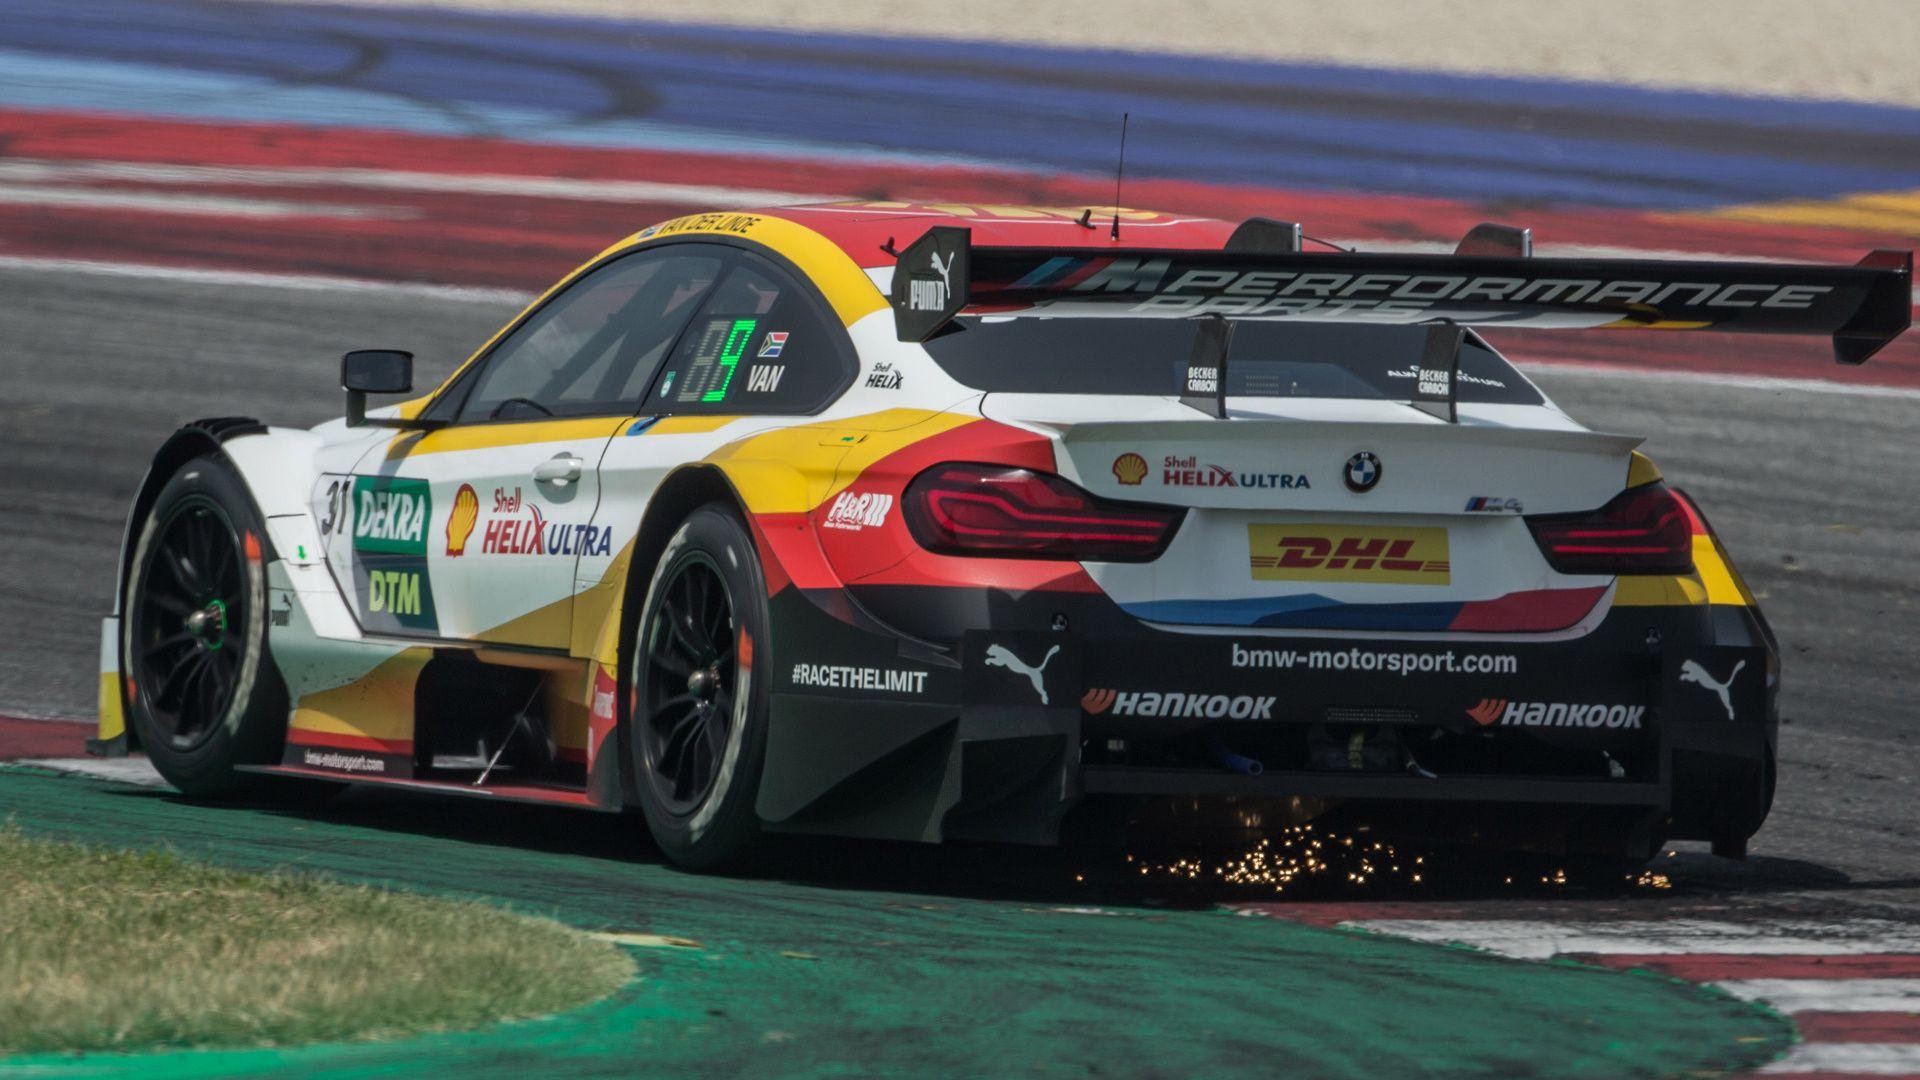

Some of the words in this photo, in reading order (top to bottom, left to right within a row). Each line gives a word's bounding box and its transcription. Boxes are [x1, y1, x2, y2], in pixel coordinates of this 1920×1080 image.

[686, 214, 723, 231] DER
[713, 216, 761, 234] LINDE
[910, 280, 945, 311] PUMA
[1163, 270, 1832, 309] PERFORMANCE
[1128, 294, 1436, 324] PARTS
[702, 319, 757, 402] 9
[872, 361, 892, 372] Shell
[1188, 366, 1218, 379] BECKER
[746, 364, 786, 392] VAN
[864, 369, 904, 390] HELIX
[1187, 379, 1218, 392] CARBON
[1418, 382, 1450, 396] CARBON
[1419, 369, 1450, 383] BECKER
[1163, 464, 1239, 488] HELIX
[1240, 473, 1312, 489] ULTRA
[1164, 455, 1197, 469] Shell
[321, 480, 350, 536] 31
[356, 488, 425, 542] DEKRA
[492, 487, 522, 514] Shell
[482, 505, 548, 555] HELIX
[548, 524, 612, 557] ULTRA
[1276, 536, 1424, 572] DHL
[368, 570, 421, 616] DTM
[1231, 643, 1518, 677] bmw-motorsport.com
[792, 663, 928, 694] #RACETHELIMIT
